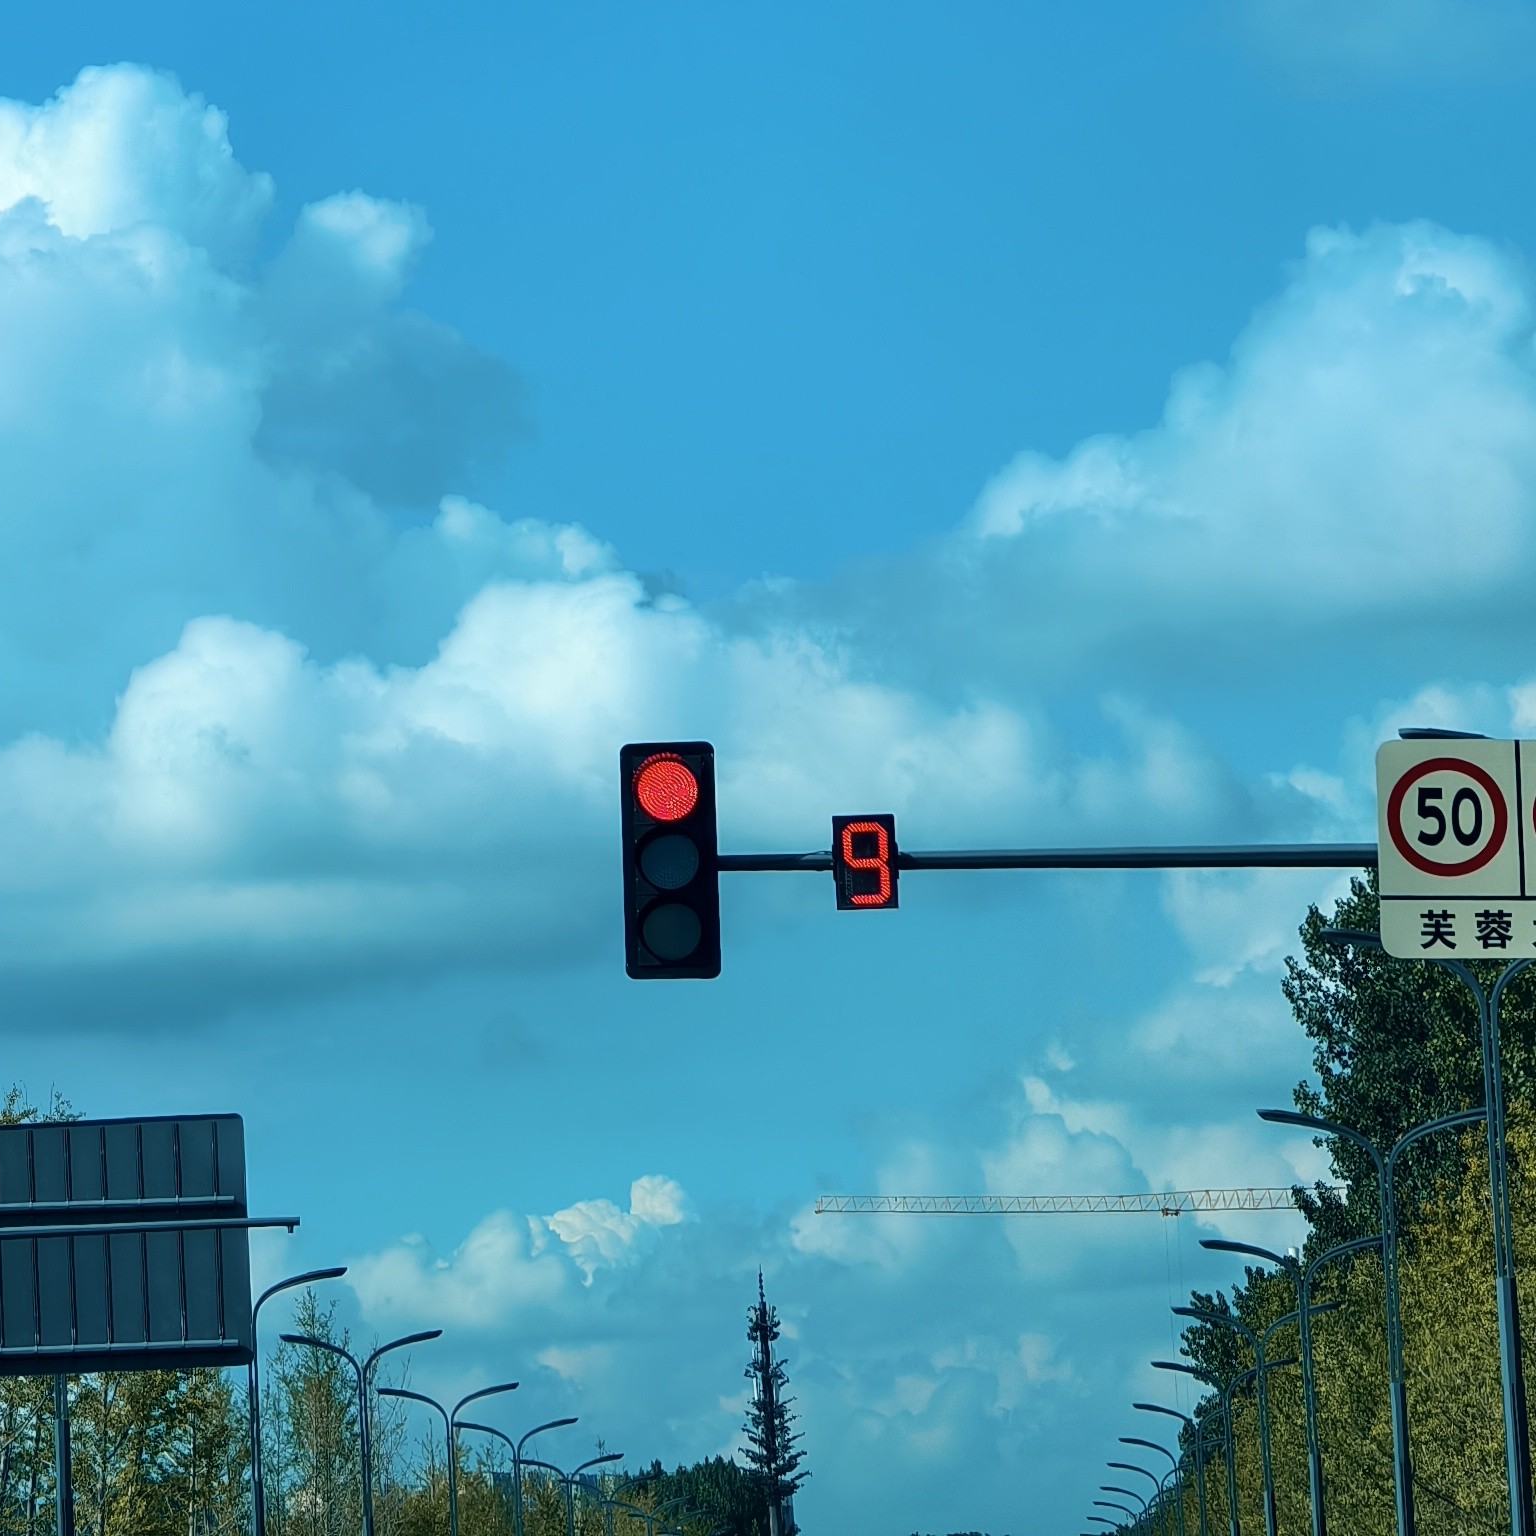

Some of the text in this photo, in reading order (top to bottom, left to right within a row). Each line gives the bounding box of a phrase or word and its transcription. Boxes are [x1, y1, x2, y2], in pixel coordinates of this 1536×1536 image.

[1417, 787, 1483, 846] 50
[842, 822, 890, 905] 9
[1420, 909, 1536, 950] 芙蓉
